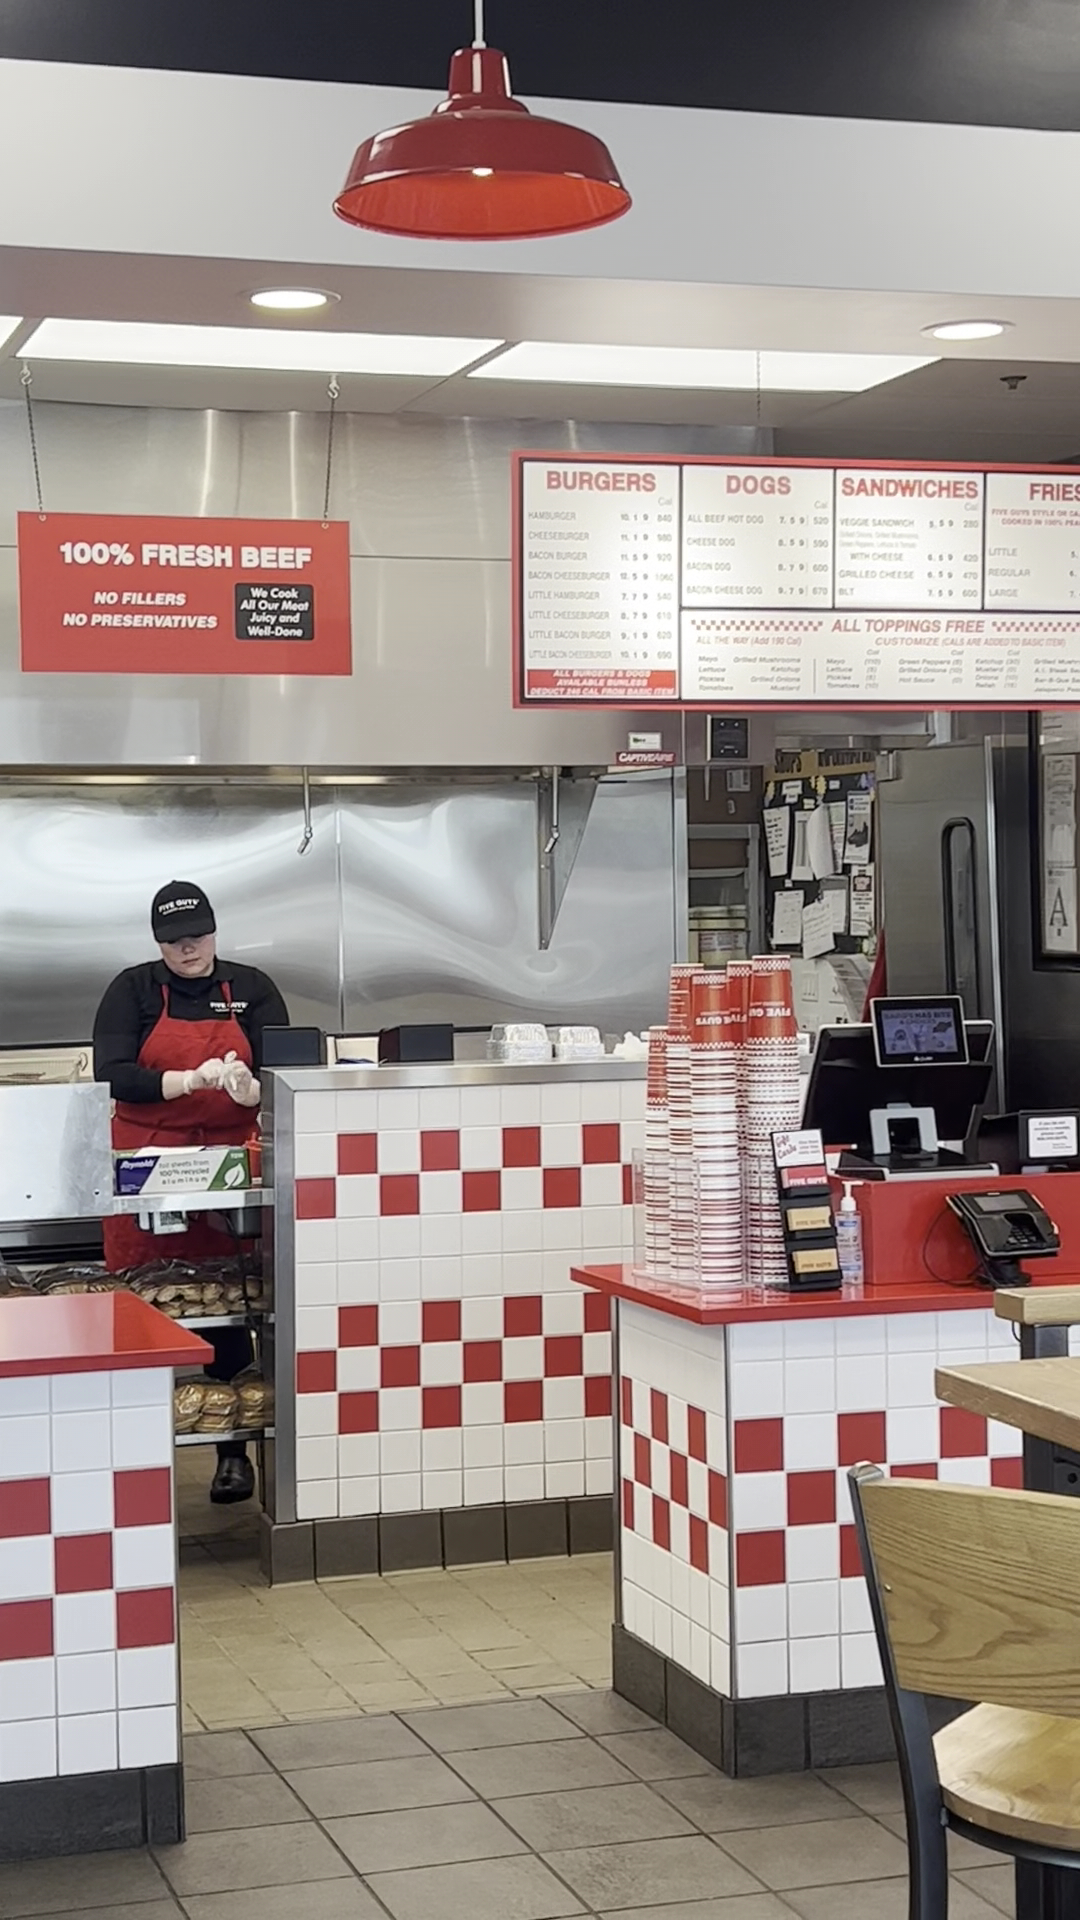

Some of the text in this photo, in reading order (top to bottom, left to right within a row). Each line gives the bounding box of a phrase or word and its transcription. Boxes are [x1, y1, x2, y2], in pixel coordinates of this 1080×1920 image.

[546, 471, 656, 492] BURGERS
[725, 475, 792, 495] DOGS
[841, 477, 978, 499] SANDWICHES
[658, 497, 673, 506] Cal
[814, 501, 828, 509] Cal
[964, 503, 978, 512] Cal
[528, 511, 576, 521] HAMBURGER
[992, 508, 1008, 516] FIVE
[1032, 509, 1055, 517] STYLE
[657, 514, 673, 523] 840
[687, 514, 764, 524] ALL BEEF HOT DOG
[813, 516, 829, 525] 520
[839, 518, 915, 528] VEGGIE SANDWICH
[1001, 518, 1032, 526] COOKED
[528, 531, 589, 541] CHEESEBURGER
[657, 534, 672, 542] 980
[686, 538, 736, 547] CHEESE DOG
[813, 539, 828, 548] 590
[60, 542, 312, 570] 100% FRESH BEEF
[528, 551, 588, 561] BACON BURGER
[988, 547, 1018, 557] LITTLE
[657, 553, 672, 562] 920
[849, 553, 903, 561] WITH CHEESE
[963, 554, 978, 562] 420
[686, 563, 731, 571] BACON DOG
[812, 564, 828, 573] 600
[528, 571, 610, 580] BACON CHEESEBURGER
[838, 570, 914, 580] GRILLED CHEESE
[963, 571, 978, 580] 470
[988, 568, 1031, 578] REGULAR
[250, 587, 299, 600] We Cook
[528, 590, 600, 600] LITTLE HAMBURGER
[686, 586, 763, 595] BACON CHEESE DOG
[812, 587, 828, 596] 670
[838, 588, 854, 596] BLT
[962, 589, 978, 598] 600
[988, 588, 1019, 598] LARGE
[94, 591, 186, 606] NO FILLERS
[240, 598, 309, 612] All Our Meat
[250, 611, 301, 625] Juicy and
[528, 610, 610, 620] LITTLE CHEESEBURGER
[63, 612, 218, 629] NO PRESERVATIVES
[831, 619, 985, 634] ALL TOPPINGS FREE
[248, 626, 303, 638] Well-Done
[528, 630, 611, 639] LITTLE BACON BURGER
[696, 636, 711, 645] ALL
[714, 637, 729, 645] THE
[733, 637, 749, 645] WAY
[751, 636, 770, 646] (Add
[771, 636, 784, 645] 190
[875, 636, 940, 647] CUSTOMIZE
[941, 637, 965, 647] (CALS
[966, 638, 982, 646] ARE
[983, 638, 1010, 646] ADDED
[1021, 638, 1044, 647] BASIC
[528, 650, 612, 659] LITTLE BACON CHEESEBURGER
[573, 670, 615, 678] BURGERS
[557, 679, 648, 687] AVAILABLE BUNLESS
[529, 687, 565, 696] DEDUCT
[582, 687, 599, 696] CAL
[601, 687, 625, 696] FROM
[1049, 888, 1068, 927] A
[749, 1007, 792, 1017] FIVE GU
[695, 1016, 722, 1026] GUYS
[171, 1160, 193, 1169] sheets
[181, 1167, 209, 1175] recycled
